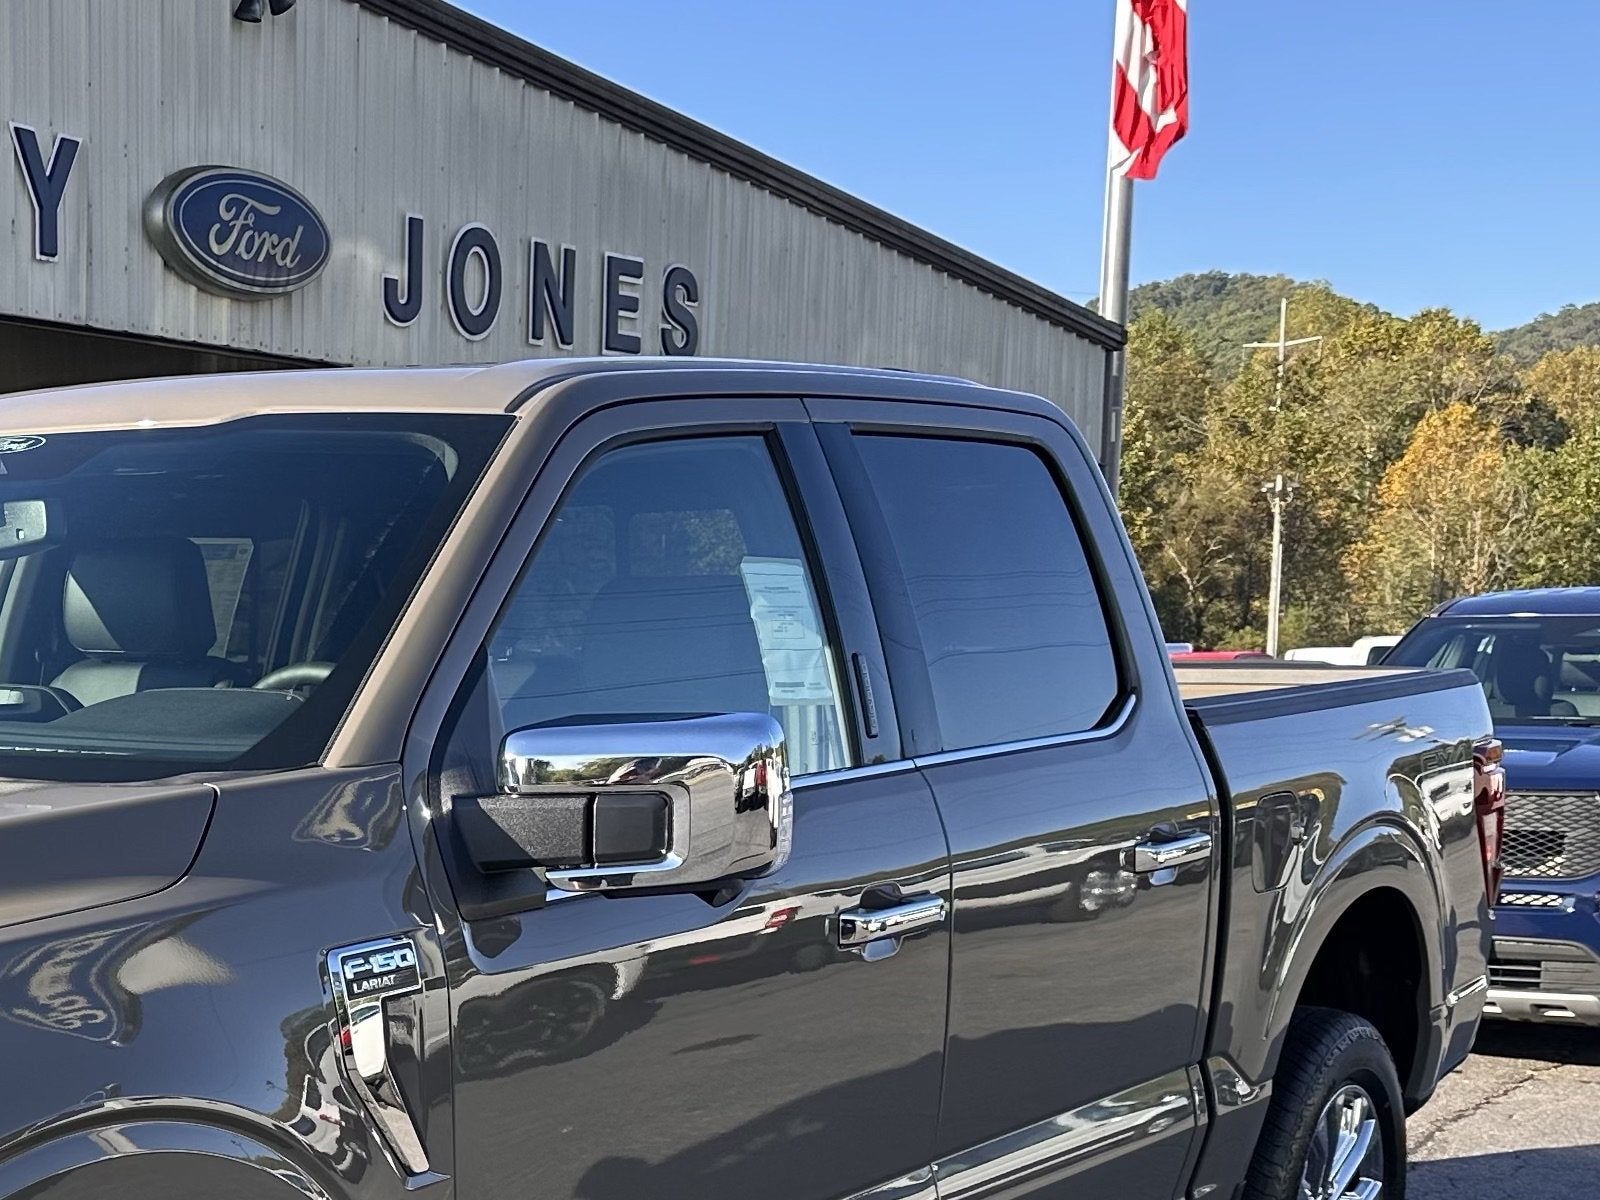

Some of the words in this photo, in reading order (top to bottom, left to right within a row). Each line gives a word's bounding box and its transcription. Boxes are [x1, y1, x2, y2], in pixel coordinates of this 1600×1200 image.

[208, 193, 304, 270] Ford
[381, 213, 699, 357] JONES
[343, 948, 415, 979] F-150
[353, 974, 396, 993] LARIAT
